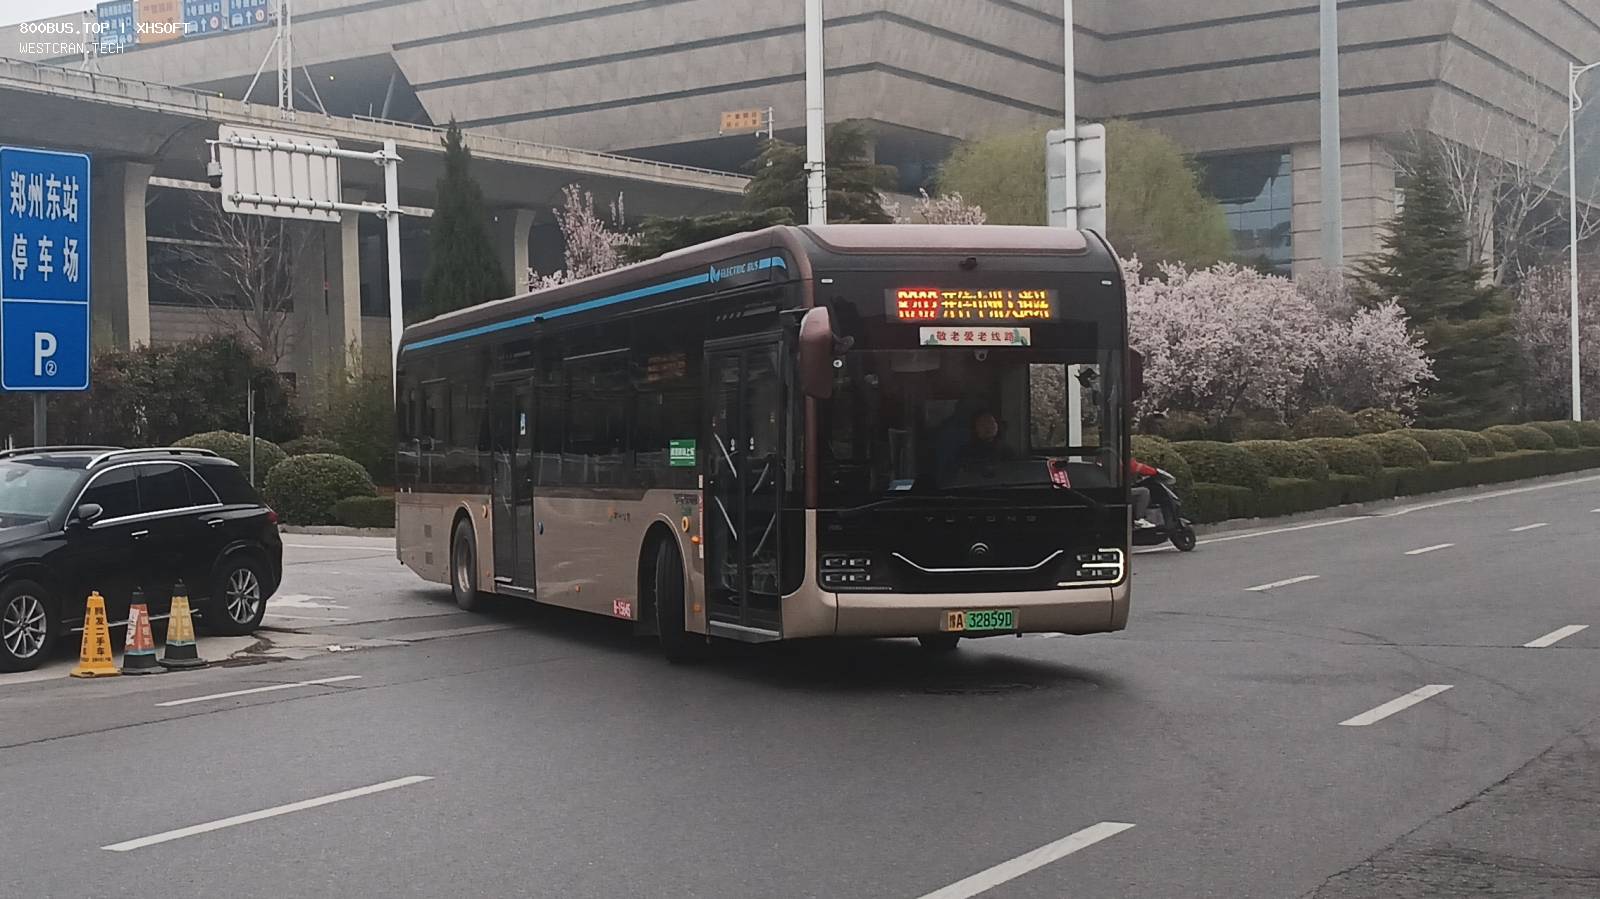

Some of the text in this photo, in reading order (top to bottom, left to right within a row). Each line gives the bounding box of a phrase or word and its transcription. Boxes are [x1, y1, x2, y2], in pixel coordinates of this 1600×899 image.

[10, 170, 79, 223] 郑州东站
[11, 232, 79, 283] 停车场
[720, 263, 746, 278] ELECTRIC
[936, 329, 1015, 342] 敬老爱老线路
[34, 332, 57, 376] P
[968, 611, 1013, 628] 32859D
